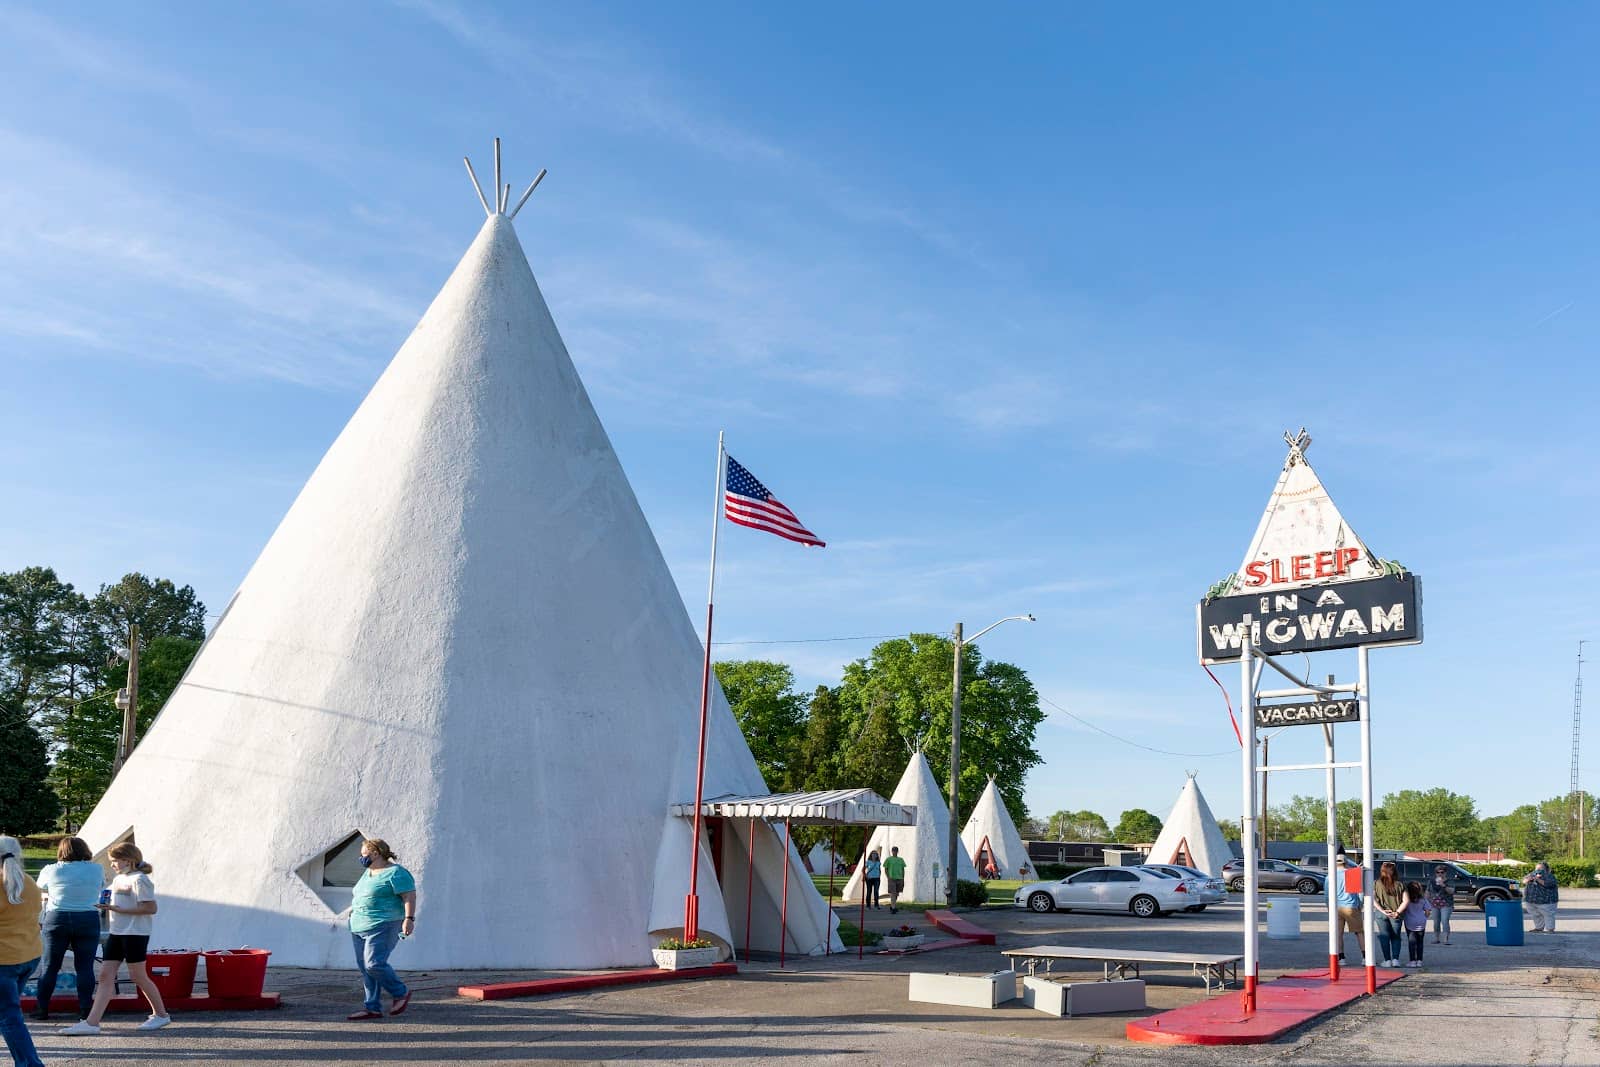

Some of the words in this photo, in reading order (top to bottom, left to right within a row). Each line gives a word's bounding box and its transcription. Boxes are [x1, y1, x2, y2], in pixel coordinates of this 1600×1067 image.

[1245, 547, 1360, 587] SLEEP
[1260, 594, 1298, 614] IN
[1316, 589, 1344, 607] A
[1208, 603, 1405, 650] WIGWAM
[1258, 701, 1352, 722] VACANCY
